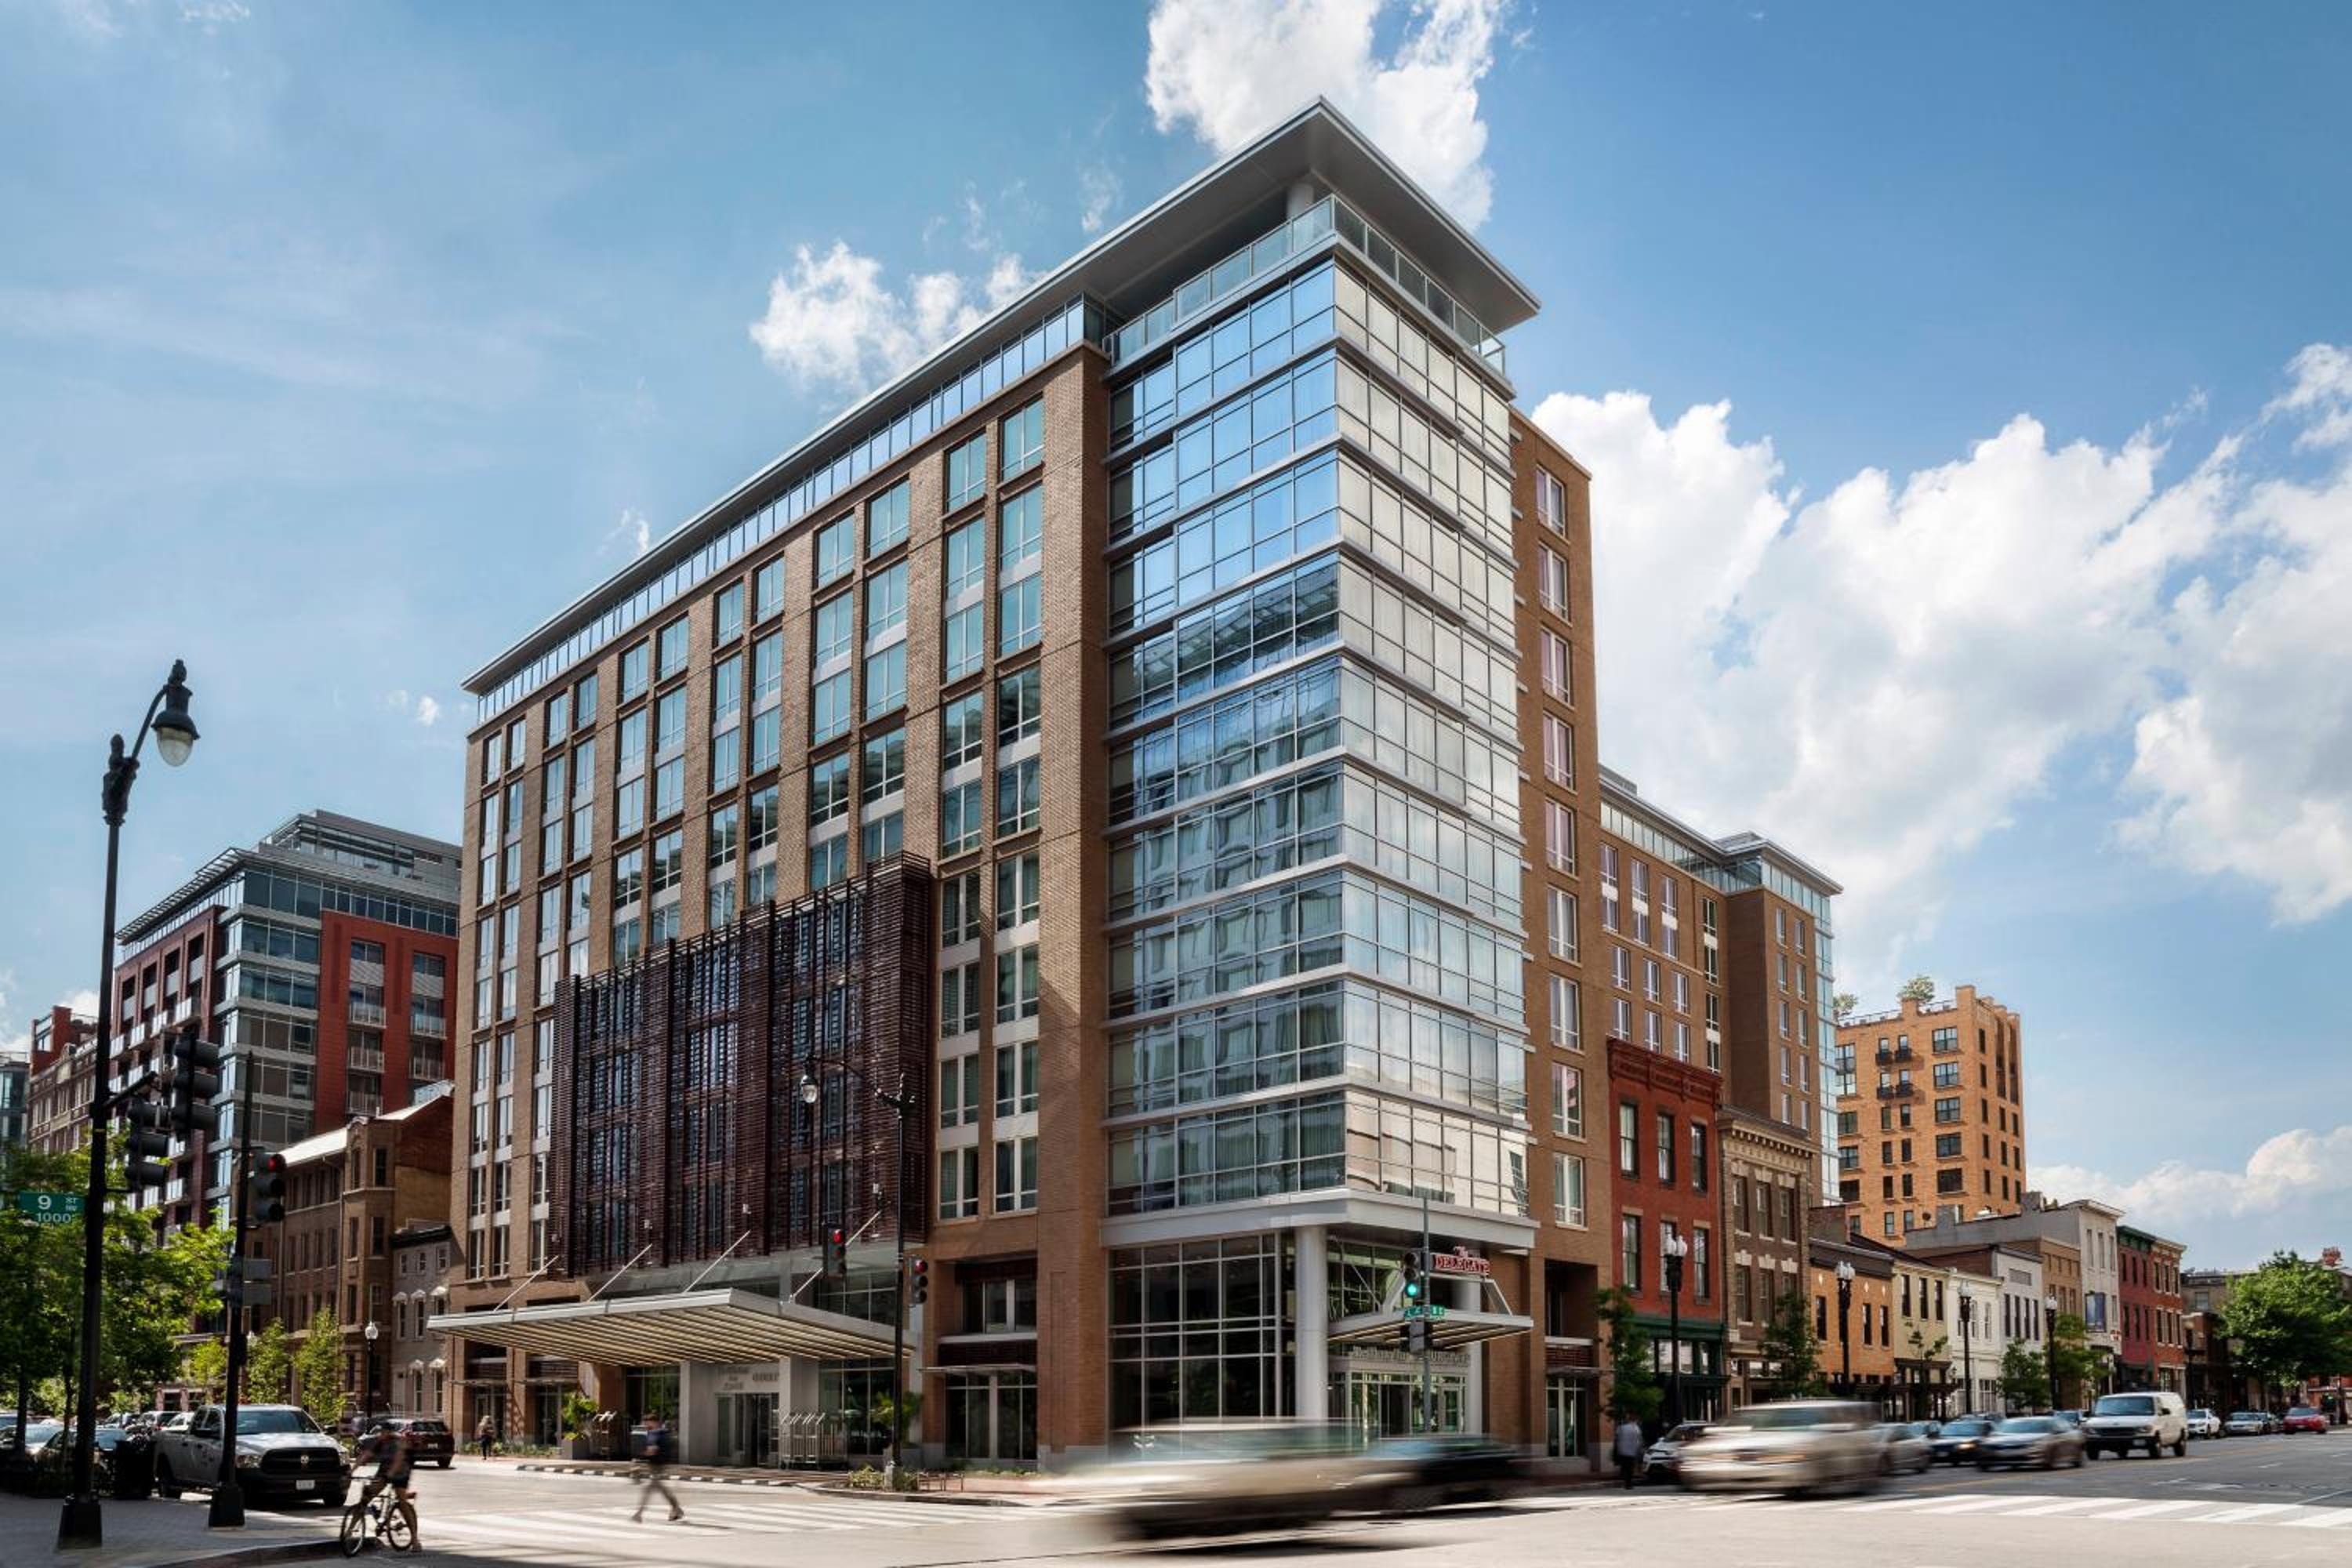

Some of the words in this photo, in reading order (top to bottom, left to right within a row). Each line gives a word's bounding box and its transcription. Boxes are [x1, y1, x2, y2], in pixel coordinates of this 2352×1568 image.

[38, 1195, 52, 1210] 9
[36, 1212, 71, 1223] 1000
[1436, 1254, 1490, 1274] DELEGATE
